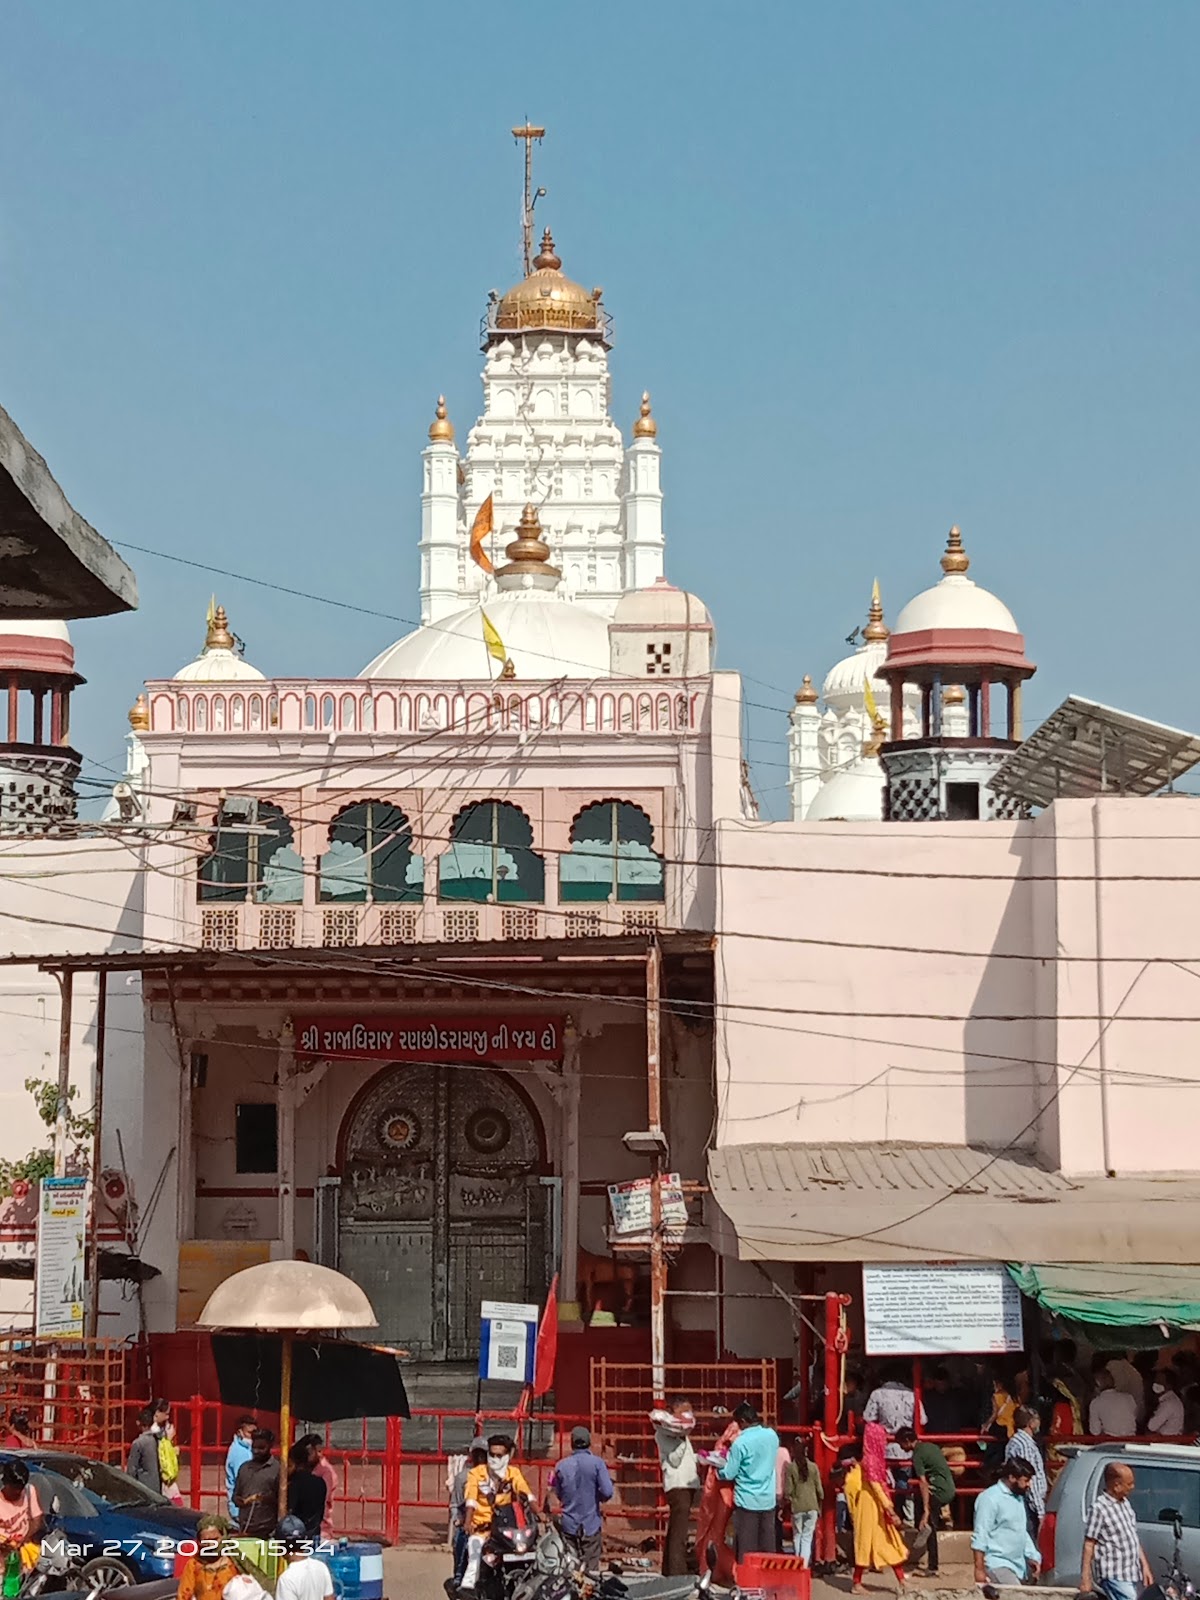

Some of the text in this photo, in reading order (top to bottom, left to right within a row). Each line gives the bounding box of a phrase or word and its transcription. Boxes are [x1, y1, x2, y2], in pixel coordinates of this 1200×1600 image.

[300, 1023, 557, 1056] શ્રી રાજાધિરાજ રણછોડરાયજી ની જય હો
